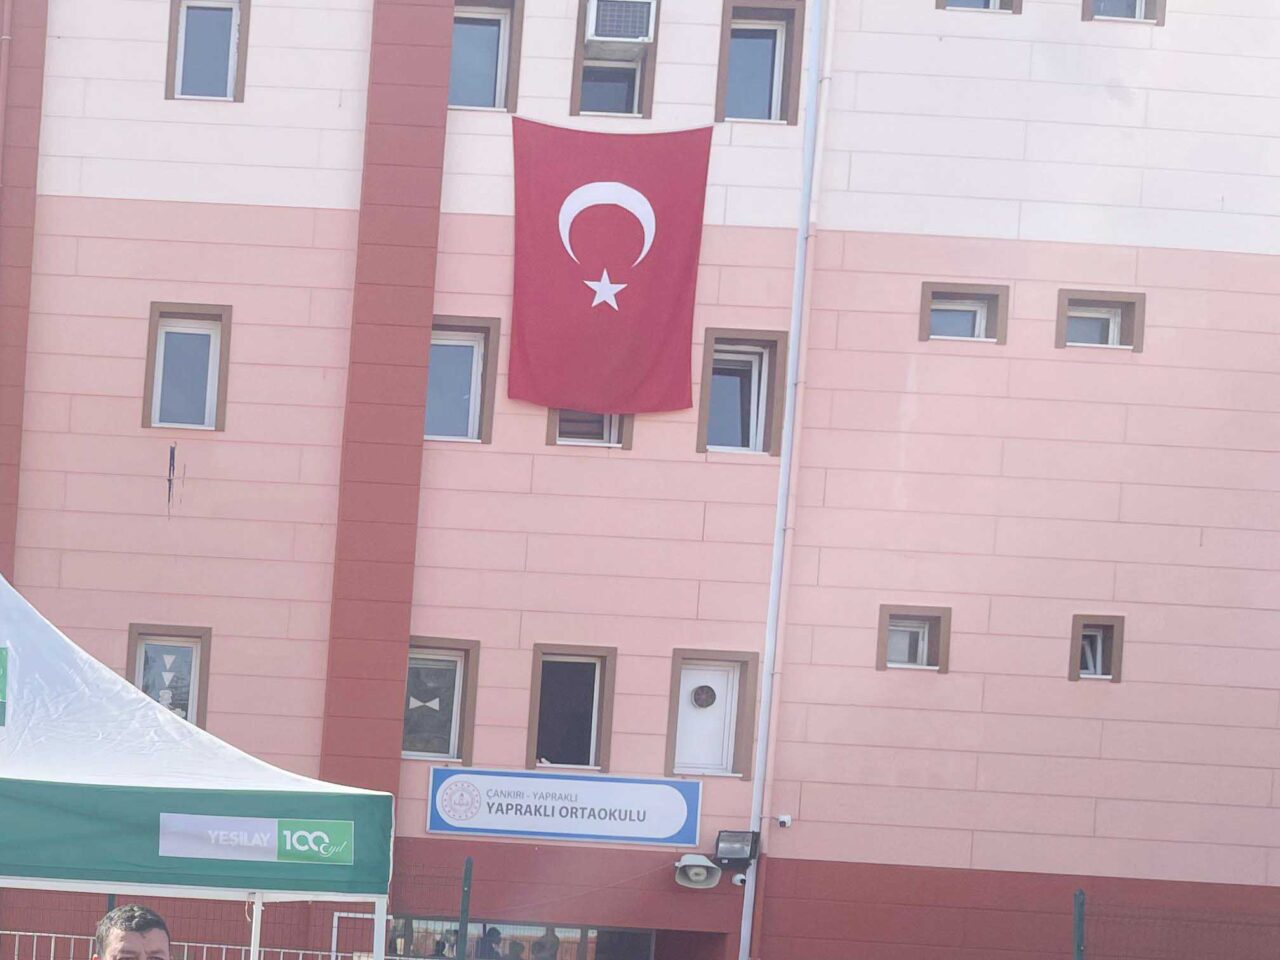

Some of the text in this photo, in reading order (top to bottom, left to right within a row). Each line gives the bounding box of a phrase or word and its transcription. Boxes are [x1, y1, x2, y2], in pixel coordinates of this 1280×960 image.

[486, 789, 524, 800] ÇANKIRI
[532, 791, 578, 802] YAPRAKLI
[486, 802, 646, 822] YAPRAKLI ORTAOKULU
